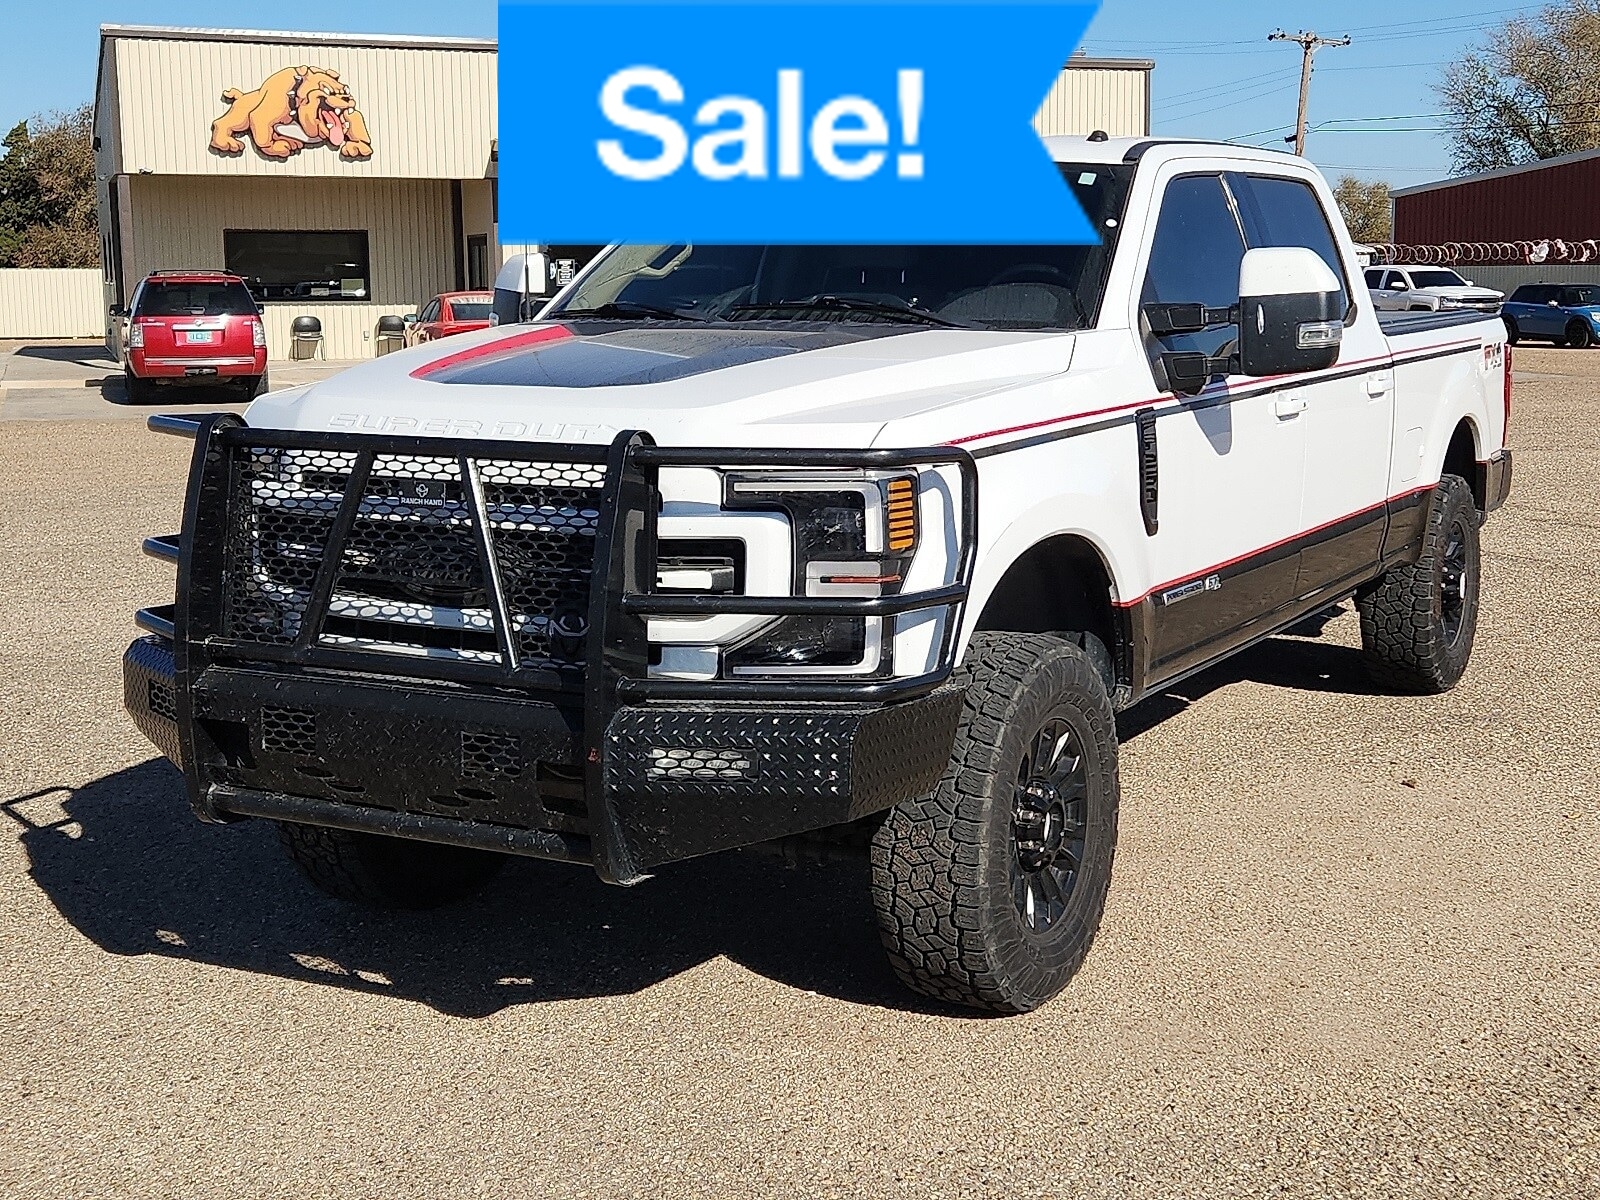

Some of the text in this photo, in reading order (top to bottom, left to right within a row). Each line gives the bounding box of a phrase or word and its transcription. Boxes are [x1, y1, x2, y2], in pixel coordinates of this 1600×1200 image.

[327, 412, 484, 436] SUPER
[400, 496, 443, 506] RANCH HAND
